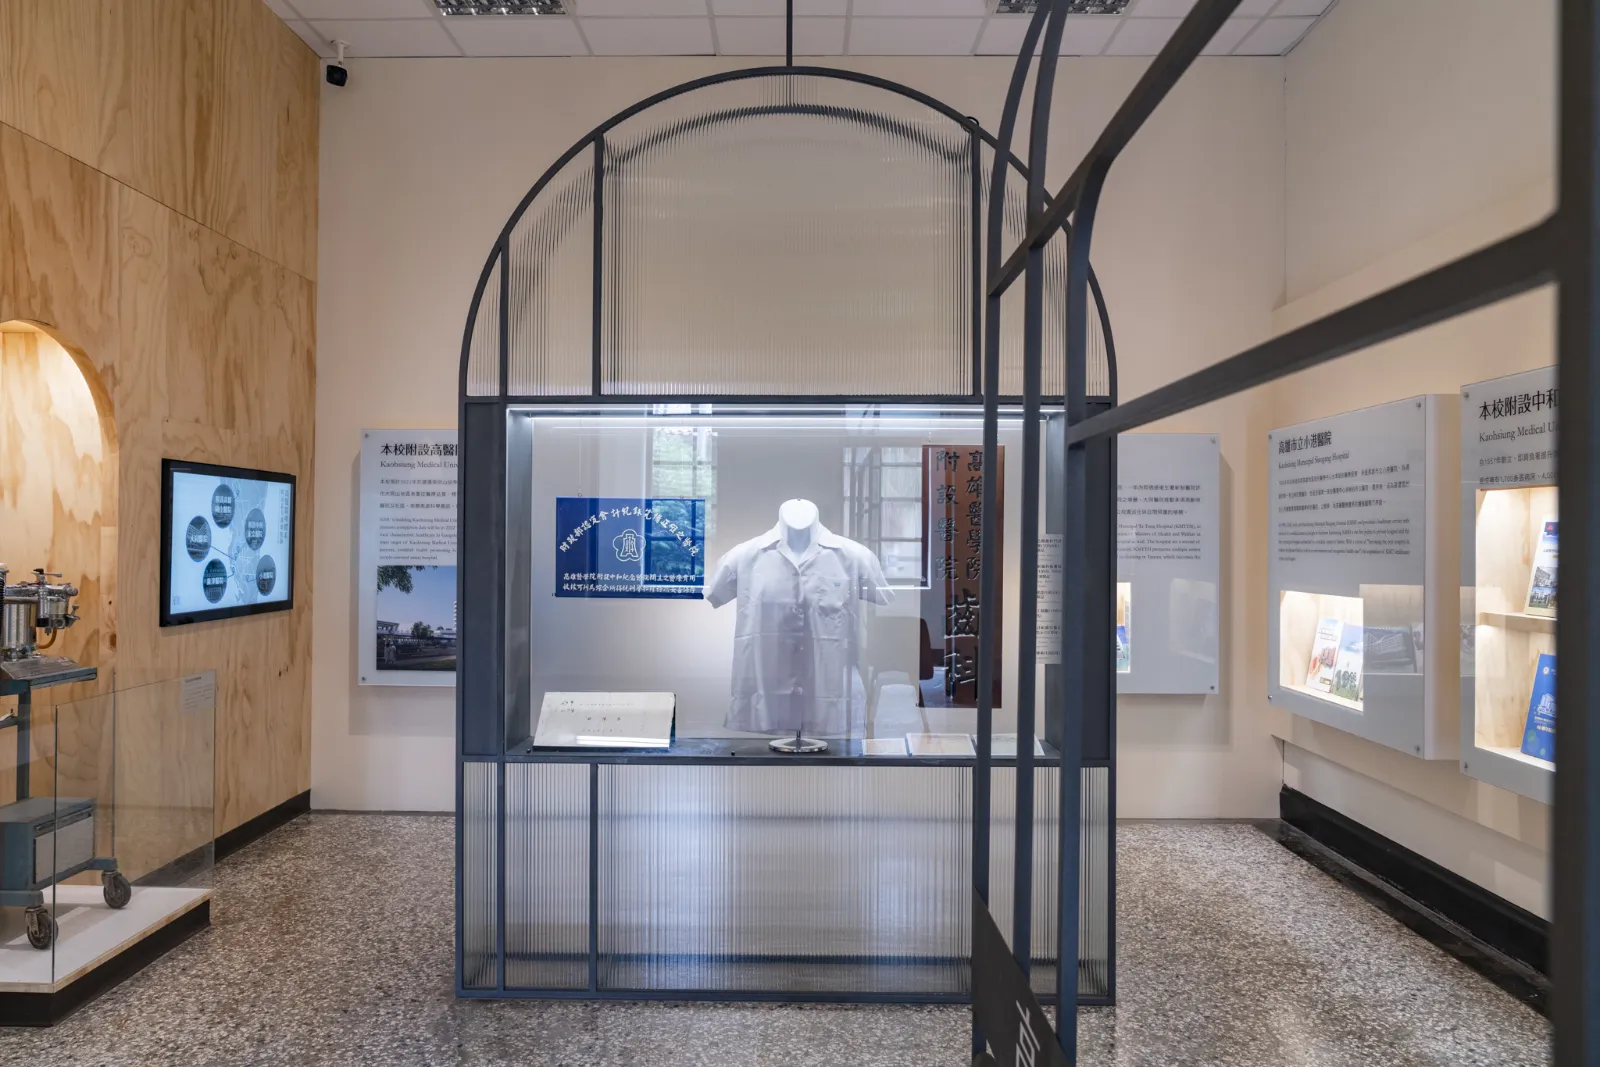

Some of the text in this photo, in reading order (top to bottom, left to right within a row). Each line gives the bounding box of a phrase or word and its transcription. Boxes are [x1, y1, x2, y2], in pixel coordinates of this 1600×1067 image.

[1479, 388, 1560, 421] 本校附設中和
[1278, 430, 1332, 455] 高雄市立小港醫院
[1479, 430, 1516, 442] Kaohsiung
[1517, 422, 1546, 437] Medical
[380, 461, 416, 470] Kaohsiung
[935, 450, 960, 582] 附設醫院
